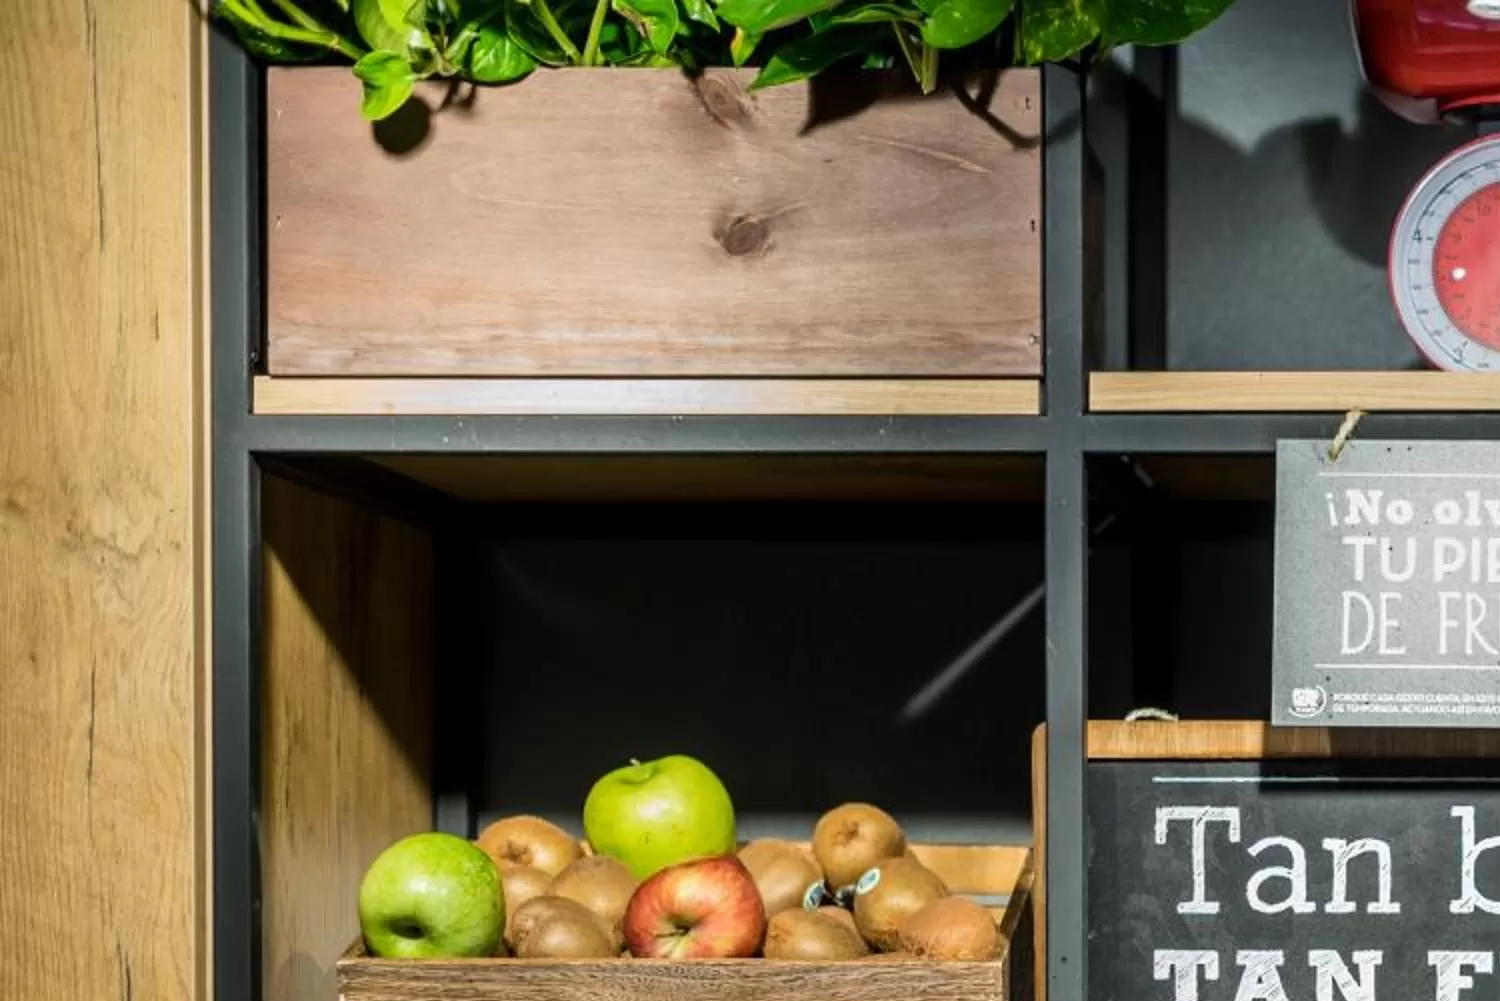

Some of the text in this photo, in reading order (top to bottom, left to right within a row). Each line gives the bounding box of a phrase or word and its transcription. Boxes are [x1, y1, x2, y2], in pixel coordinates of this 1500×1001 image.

[1326, 489, 1414, 527] ¡No
[1341, 536, 1416, 583] TU
[1340, 591, 1406, 656] DE
[1153, 805, 1402, 916] Tan
